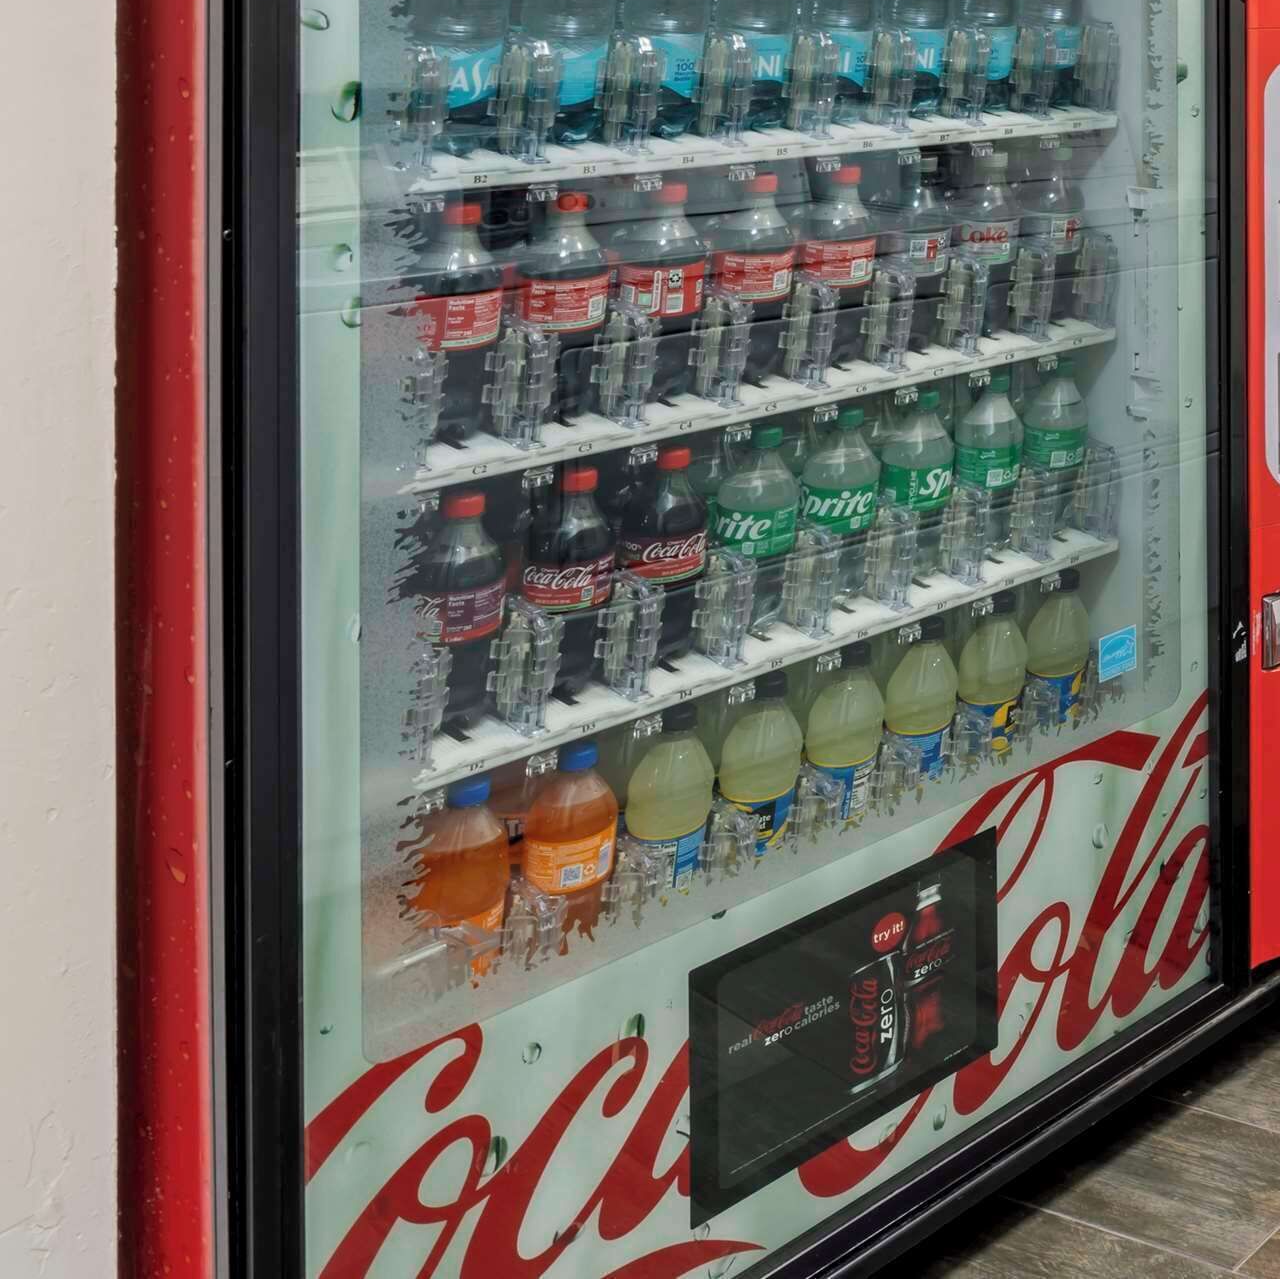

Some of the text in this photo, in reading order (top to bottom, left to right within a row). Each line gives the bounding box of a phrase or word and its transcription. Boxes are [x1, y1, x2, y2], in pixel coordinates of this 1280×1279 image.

[939, 134, 951, 142] B7
[862, 140, 874, 149] B6
[776, 147, 789, 156] B5
[682, 155, 695, 164] B4
[583, 166, 596, 175] B3
[473, 174, 488, 184] B2
[958, 223, 1009, 244] Coke
[933, 368, 945, 376] C7
[855, 385, 868, 393] C6
[764, 402, 777, 412] C5
[679, 421, 693, 430] C4
[579, 442, 593, 453] C3
[472, 464, 488, 475] C2
[716, 512, 772, 540] rite
[642, 531, 707, 564] Coca-Cola
[524, 564, 594, 590] Coca-Cola
[937, 601, 947, 610] D7
[857, 630, 868, 639] D6
[770, 658, 784, 668] D5
[679, 690, 693, 700] D4
[582, 723, 596, 733] D3
[470, 762, 485, 772] D2
[873, 920, 905, 944] try it!
[913, 957, 943, 979] zero
[303, 688, 1210, 1279] CocaCola
[880, 987, 895, 1045] zero
[728, 1033, 753, 1055] real
[804, 993, 835, 1016] taste
[763, 1001, 841, 1048] zero calories
[849, 976, 880, 1076] Coca-Cola
